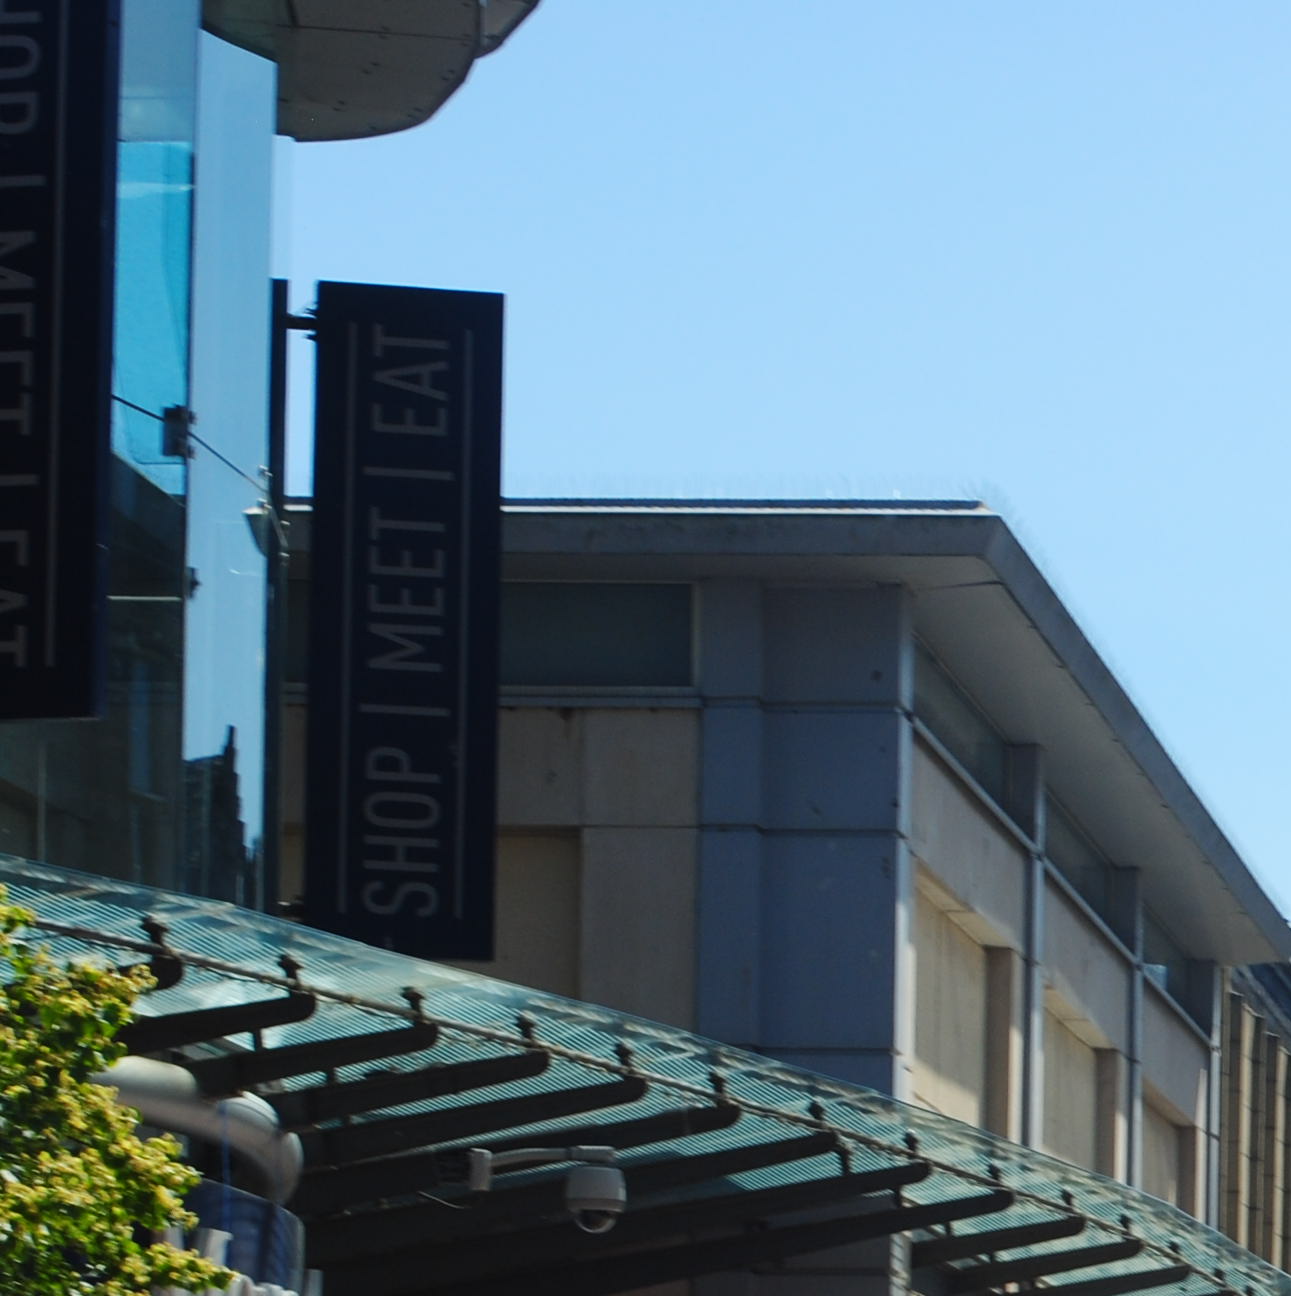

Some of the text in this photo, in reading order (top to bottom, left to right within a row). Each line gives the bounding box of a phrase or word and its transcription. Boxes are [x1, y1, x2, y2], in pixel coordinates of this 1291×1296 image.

[361, 322, 451, 917] SHOP MEET EAT
